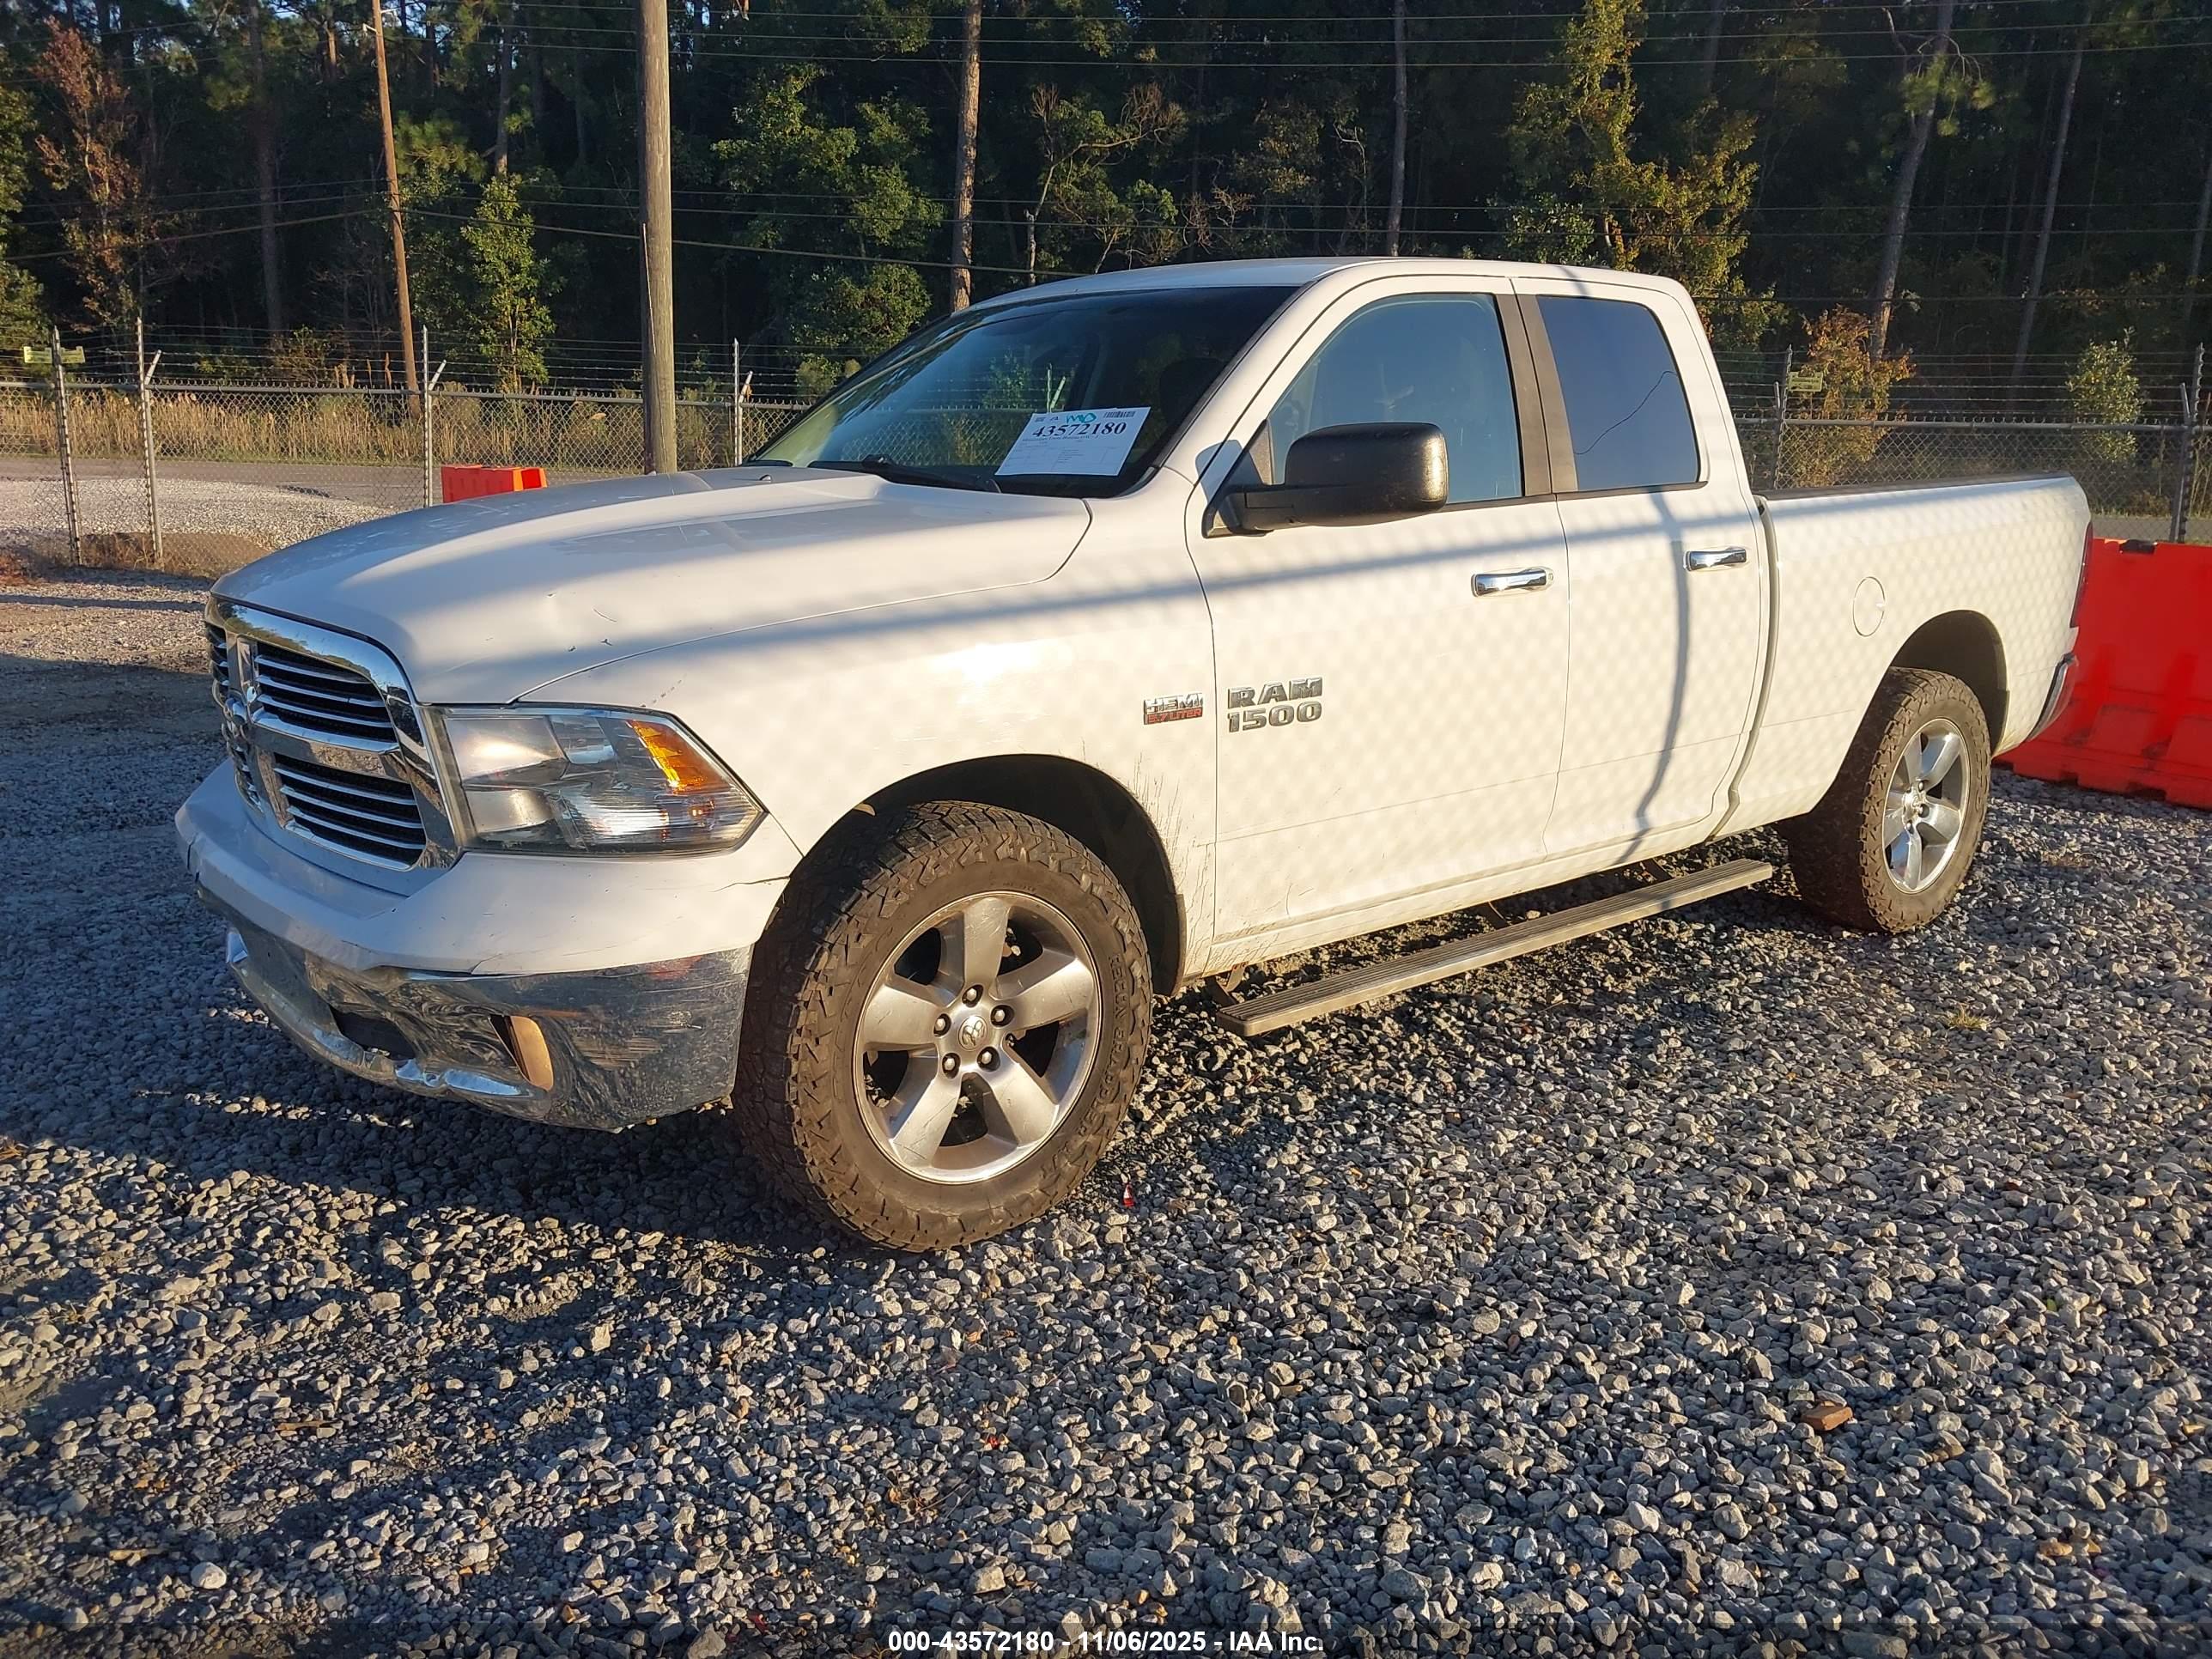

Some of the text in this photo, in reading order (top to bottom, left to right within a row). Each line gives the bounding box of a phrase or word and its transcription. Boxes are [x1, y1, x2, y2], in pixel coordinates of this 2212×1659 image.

[1032, 421, 1127, 438] 43572180
[1143, 693, 1203, 714] HEMI
[1227, 677, 1322, 709] RAM
[1146, 707, 1202, 725] 5.7 LITER
[1227, 701, 1322, 732] 1500
[1109, 954, 1128, 1019] RECON
